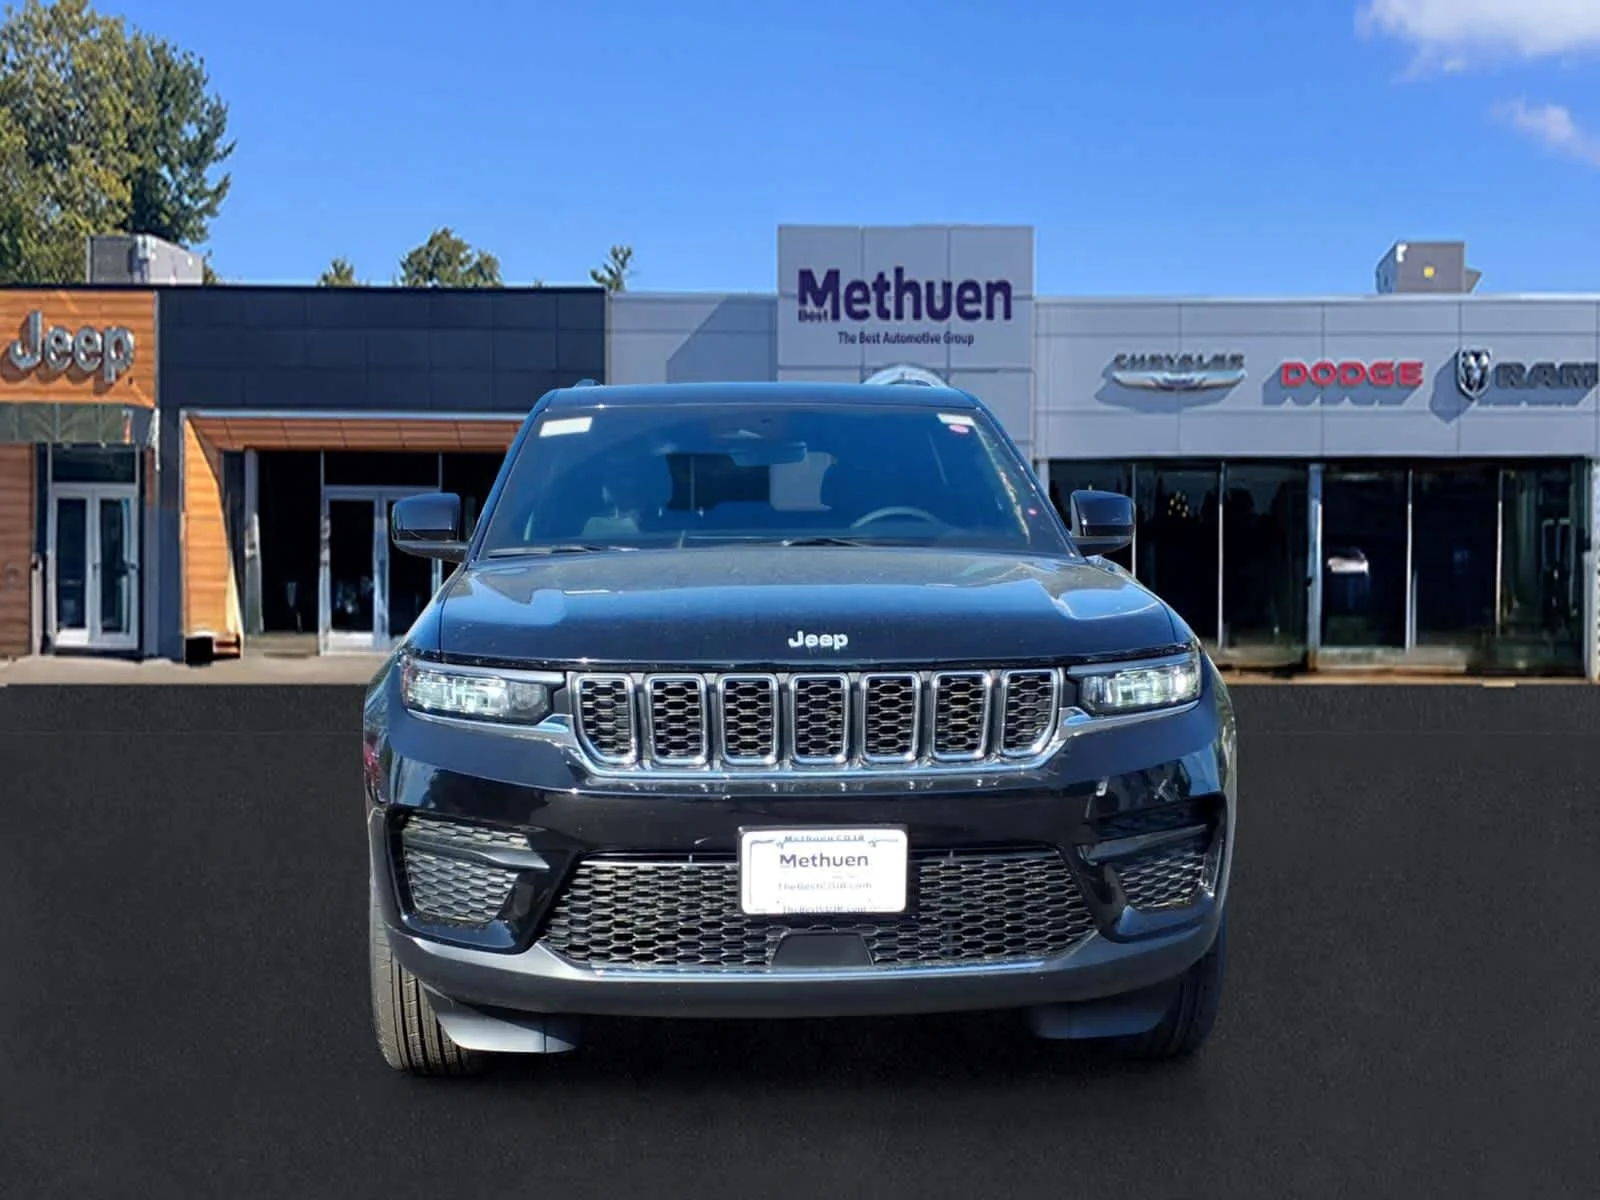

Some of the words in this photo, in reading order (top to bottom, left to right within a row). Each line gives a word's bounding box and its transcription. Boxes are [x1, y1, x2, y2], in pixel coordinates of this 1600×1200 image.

[798, 266, 1012, 321] Methuen
[9, 310, 135, 384] Jeep
[838, 331, 857, 344] The
[859, 332, 881, 345] Best
[883, 331, 941, 345] Automotive
[943, 331, 975, 347] Group
[1114, 353, 1245, 370] CHRYSLER
[1281, 361, 1424, 386] DODGE
[1495, 362, 1599, 389] RAM
[788, 629, 849, 651] Jeep
[779, 853, 869, 868] Methuen
